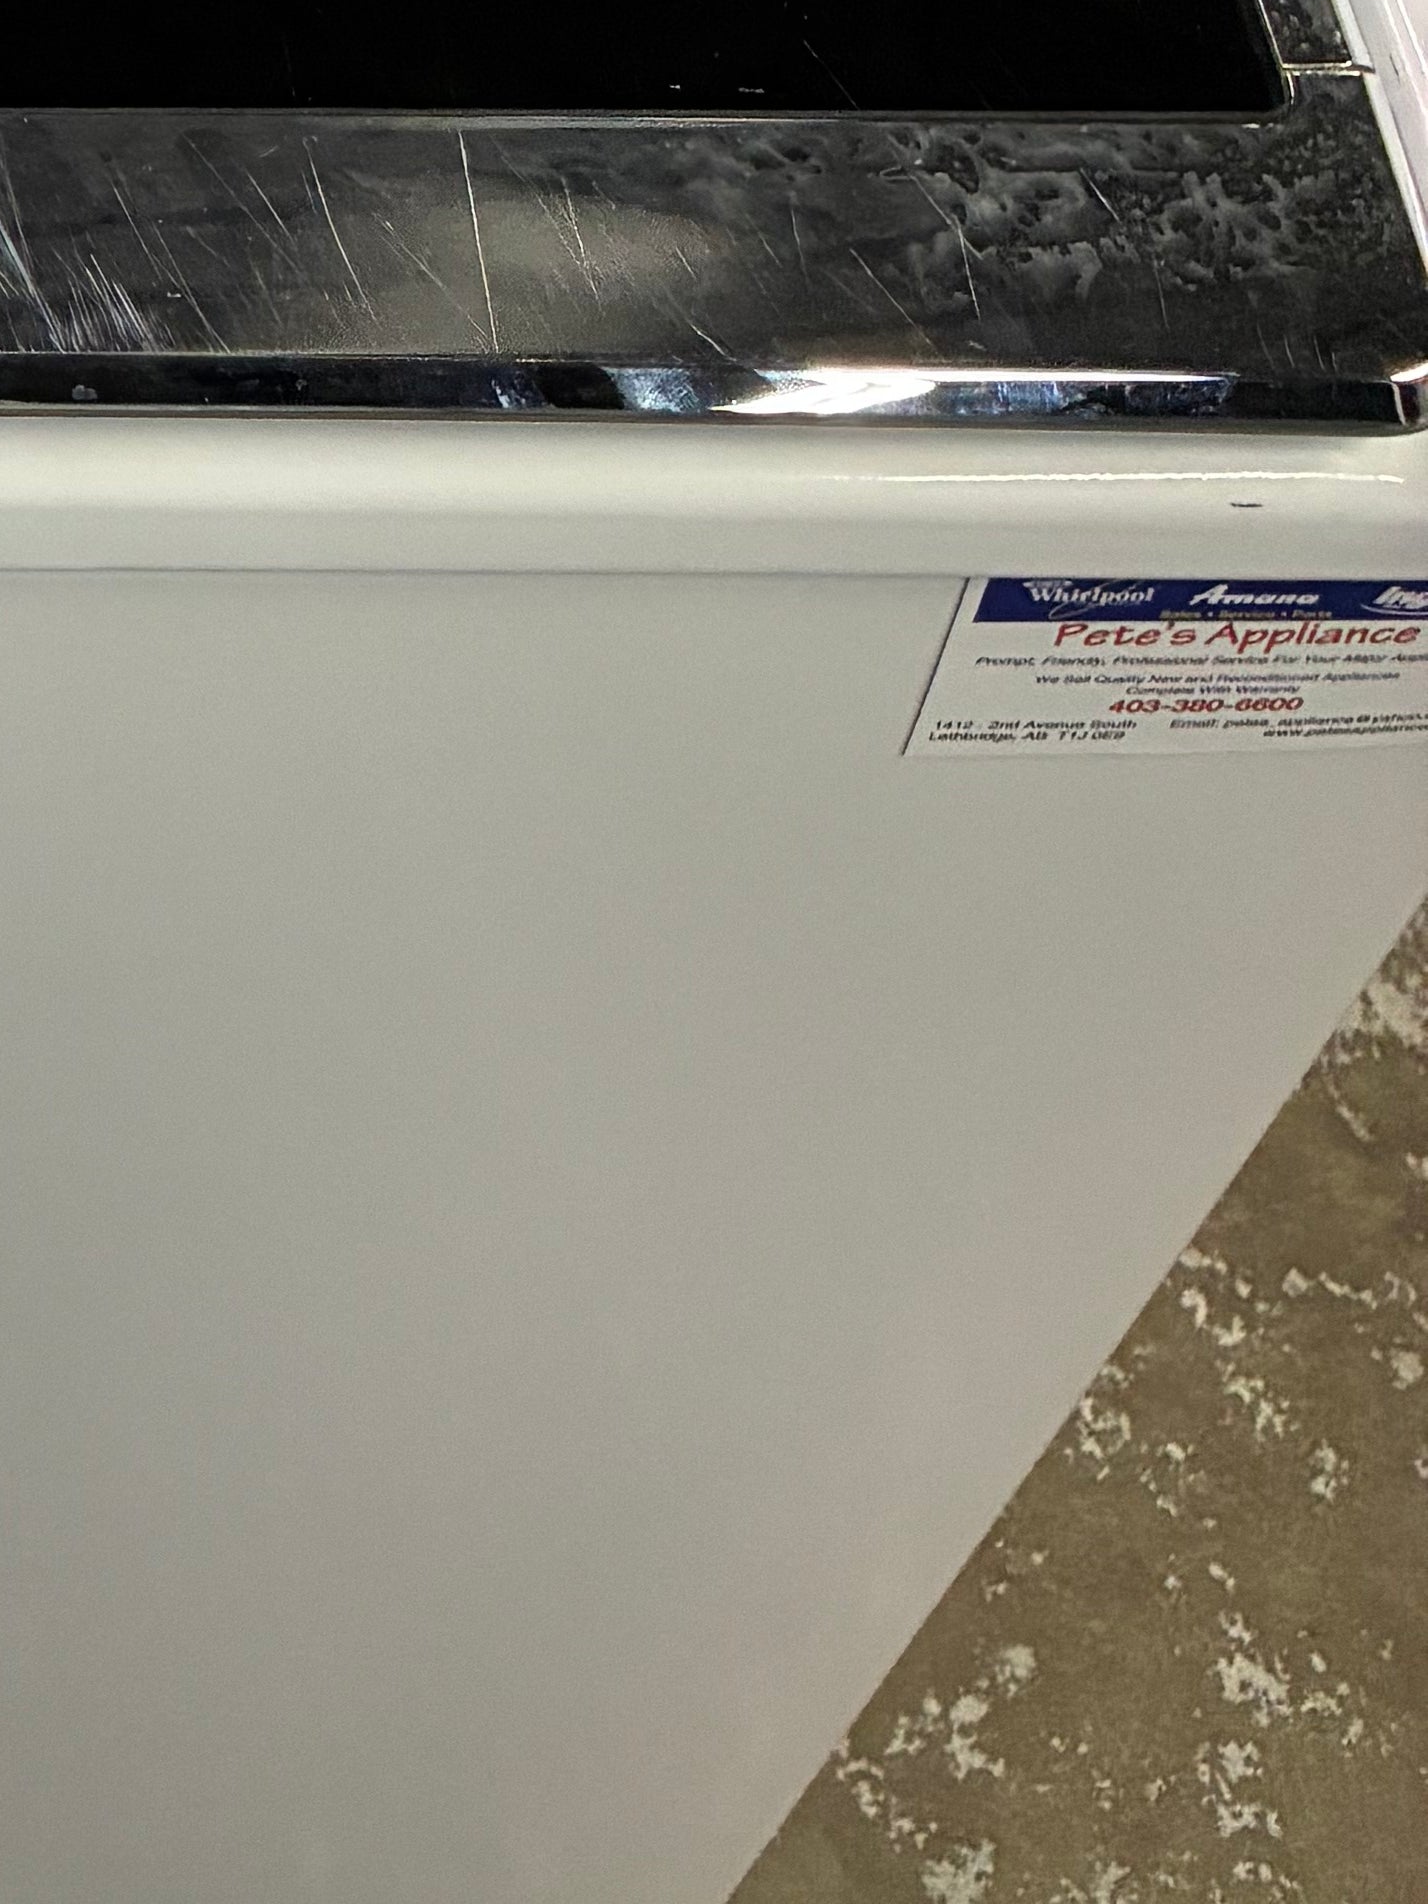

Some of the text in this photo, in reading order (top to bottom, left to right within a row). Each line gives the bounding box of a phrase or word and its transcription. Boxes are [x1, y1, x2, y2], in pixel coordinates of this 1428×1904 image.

[1028, 583, 1320, 608] Whirlpool Amana
[1053, 620, 1422, 655] Pete's Appliance
